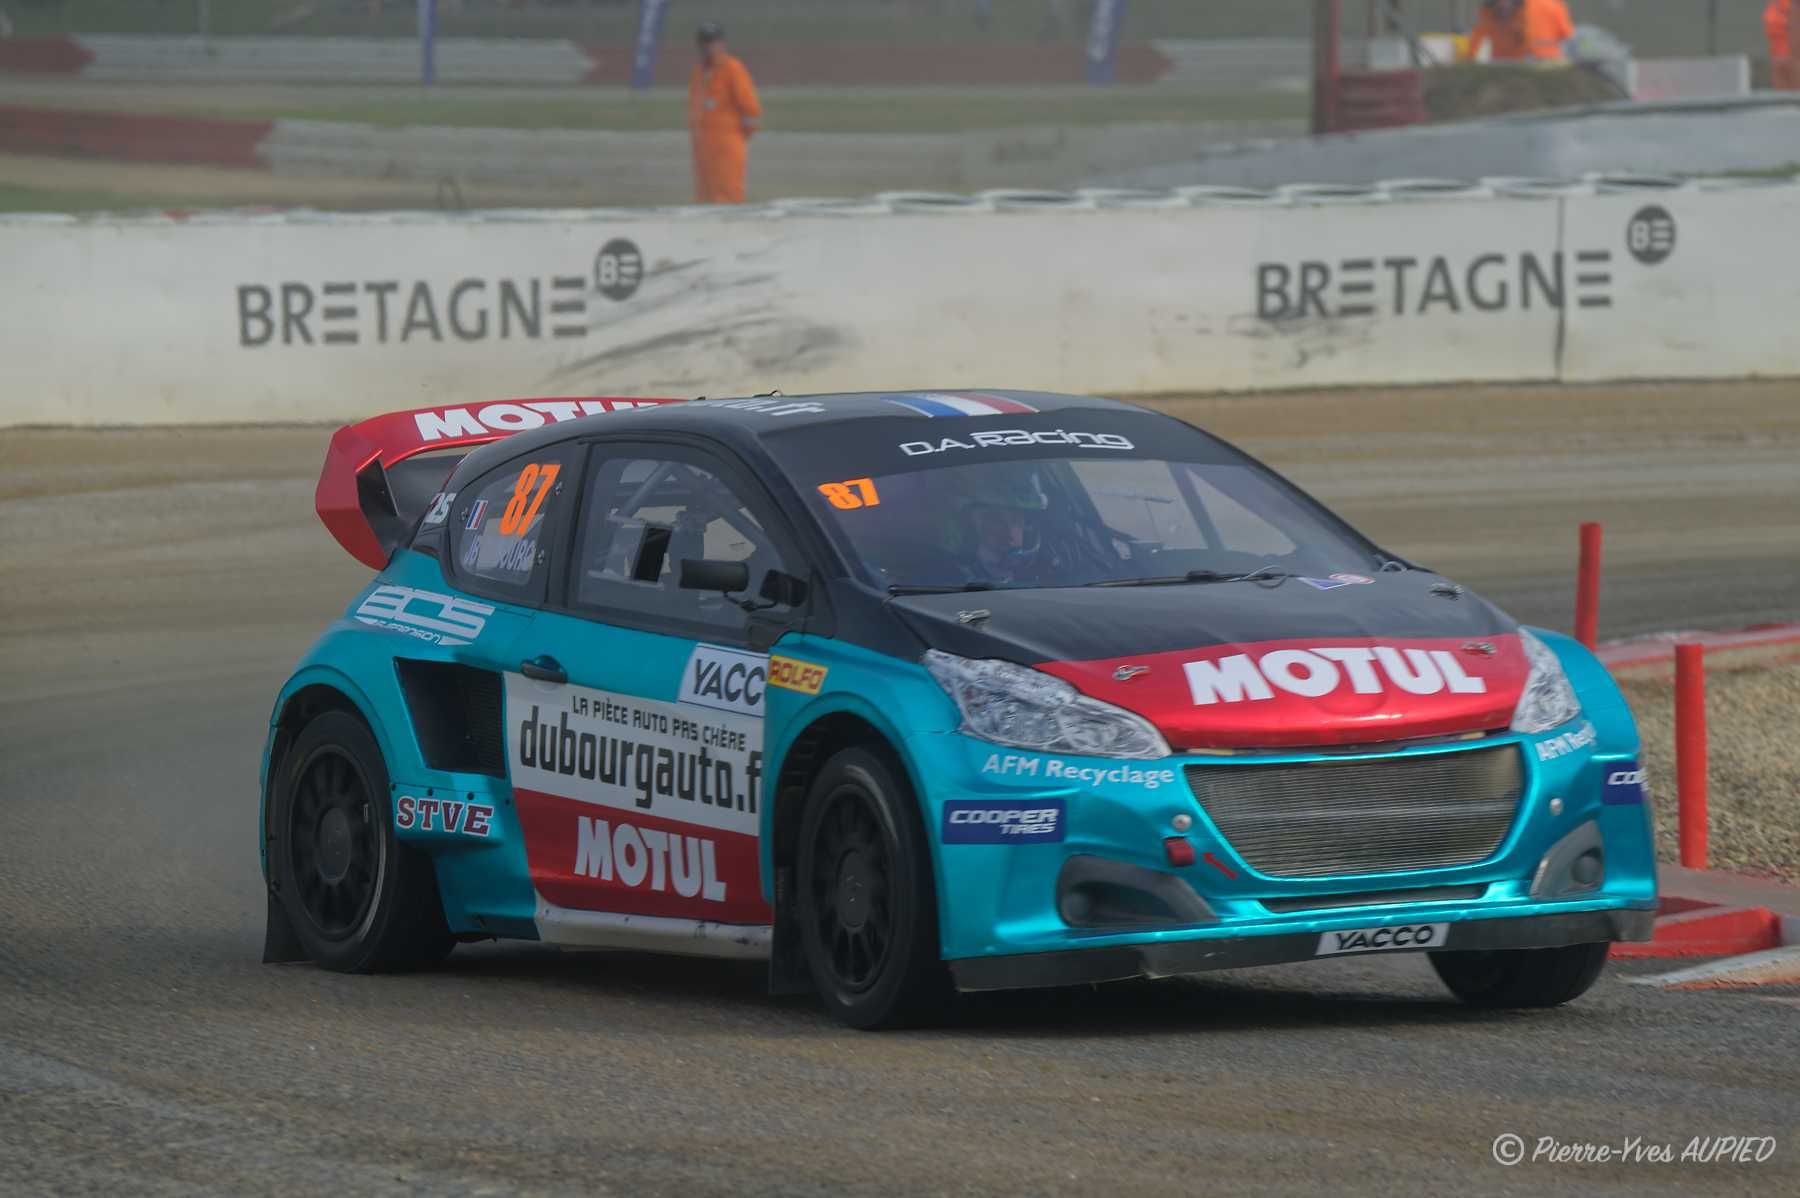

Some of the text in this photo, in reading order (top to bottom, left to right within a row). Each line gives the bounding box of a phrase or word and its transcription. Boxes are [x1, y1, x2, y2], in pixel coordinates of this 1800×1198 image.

[1256, 251, 1612, 320] BRETAGNE
[237, 276, 588, 347] BRETAGNE
[498, 463, 562, 536] 87
[817, 477, 880, 510] 87
[693, 659, 765, 706] YACC
[1182, 646, 1487, 706] MOTUL
[573, 696, 746, 751] LA PIÈCE AUTO PAS CHÈRE
[520, 705, 763, 814] dubourgauto.f
[982, 754, 1175, 789] AFM Recyclage
[397, 796, 495, 837] STVE
[949, 808, 1060, 825] COOPER
[1000, 823, 1057, 835] TIRES
[574, 816, 727, 902] MOTUL
[1336, 925, 1433, 950] YACCO
